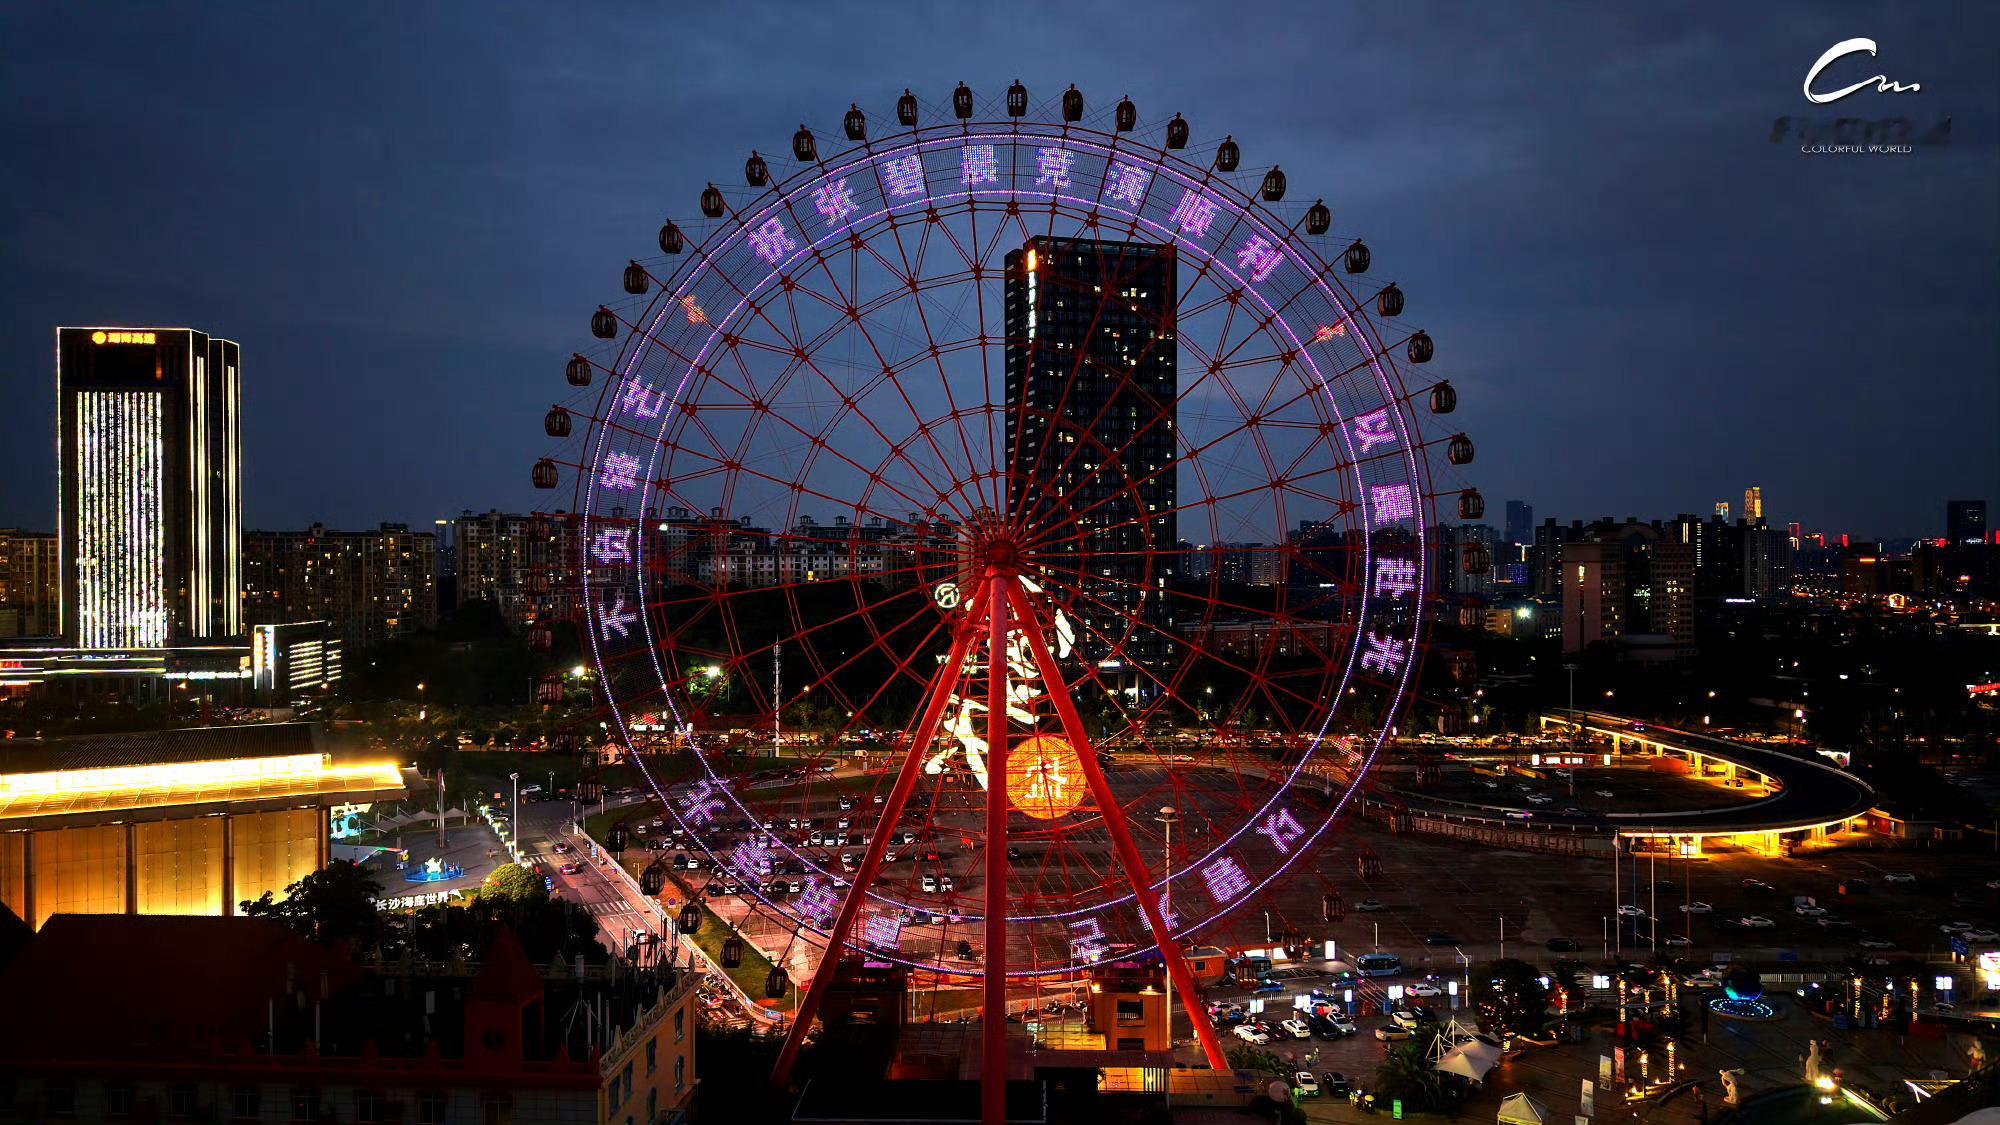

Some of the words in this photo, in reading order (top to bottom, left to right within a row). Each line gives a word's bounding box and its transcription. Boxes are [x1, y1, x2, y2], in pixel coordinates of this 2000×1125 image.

[375, 891, 449, 912] 长沙海底世界
